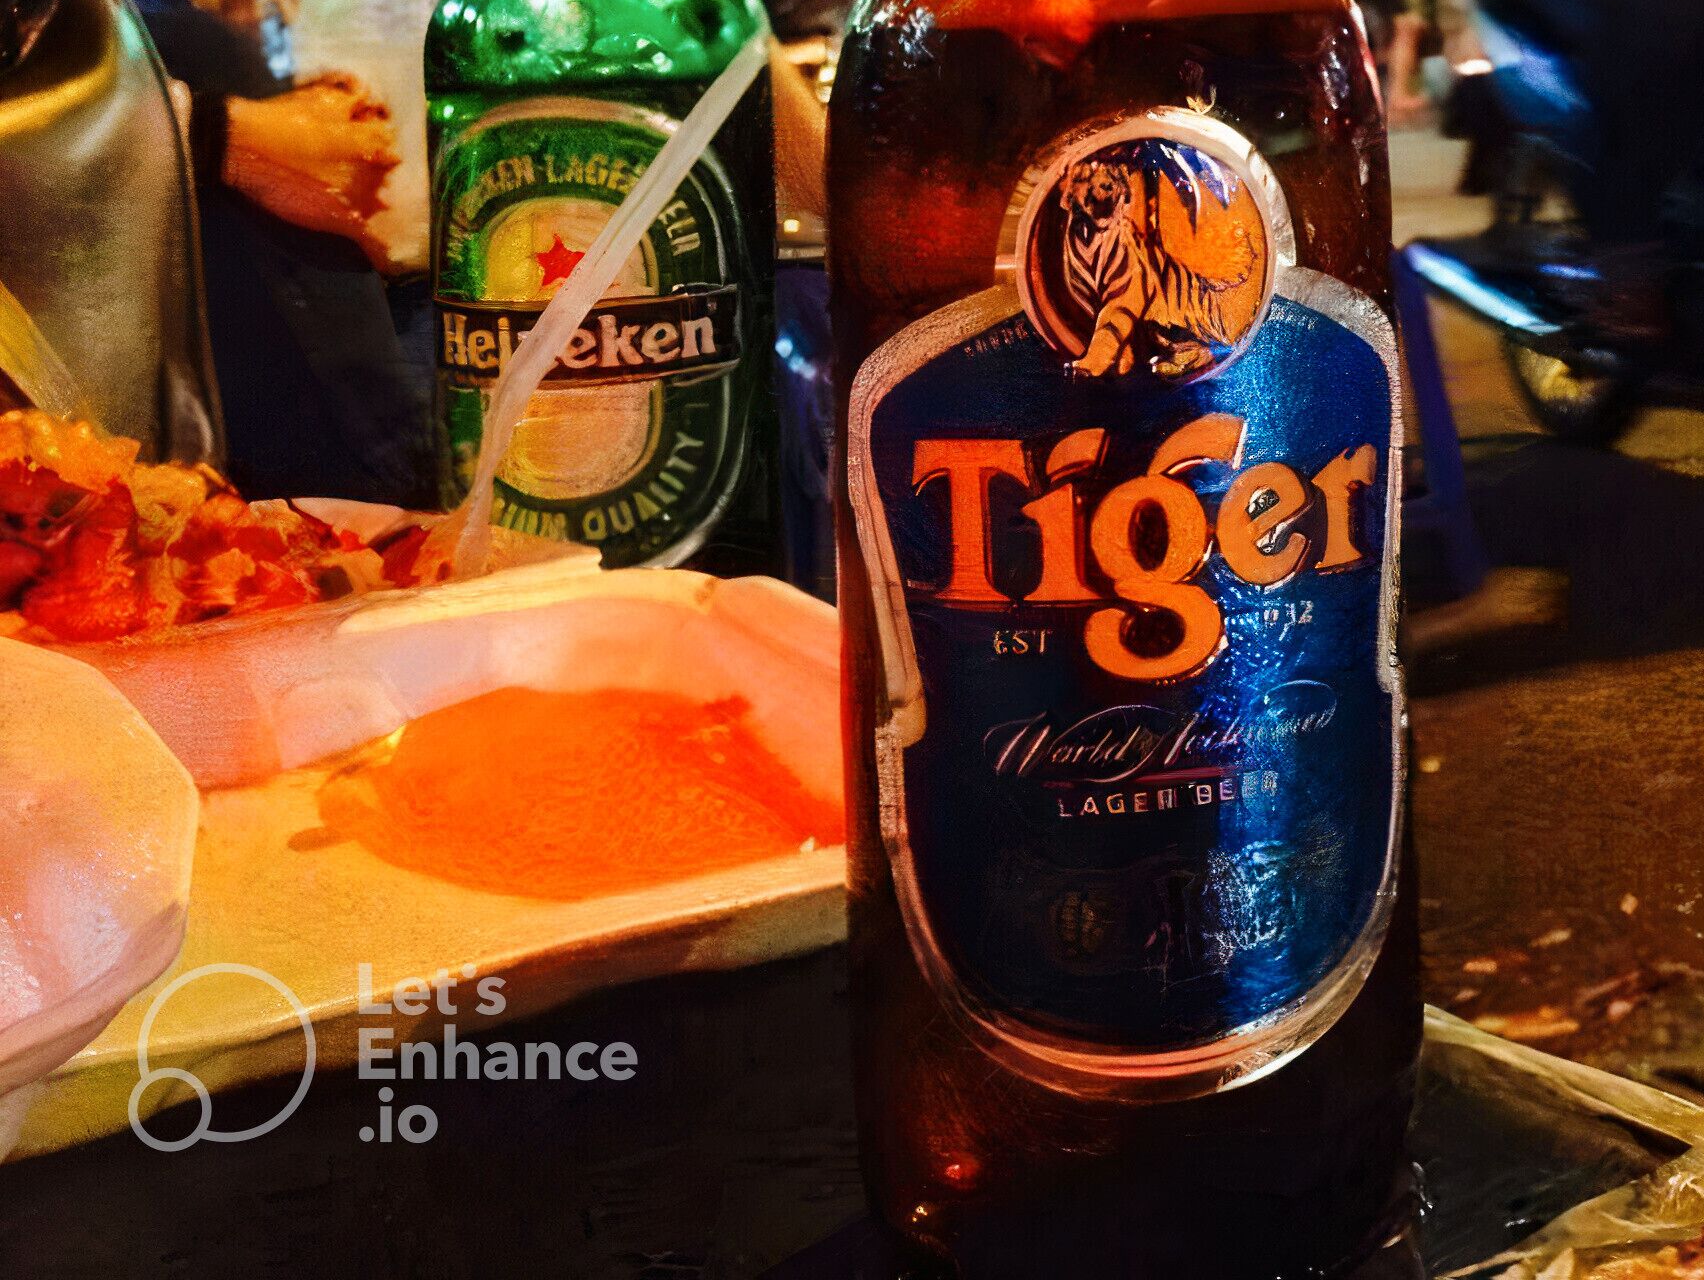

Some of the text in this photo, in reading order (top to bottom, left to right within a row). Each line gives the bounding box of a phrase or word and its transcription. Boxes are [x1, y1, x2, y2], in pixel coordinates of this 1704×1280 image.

[442, 311, 717, 370] Heieken
[582, 431, 705, 541] QUALITY
[909, 412, 1378, 681] Tiger
